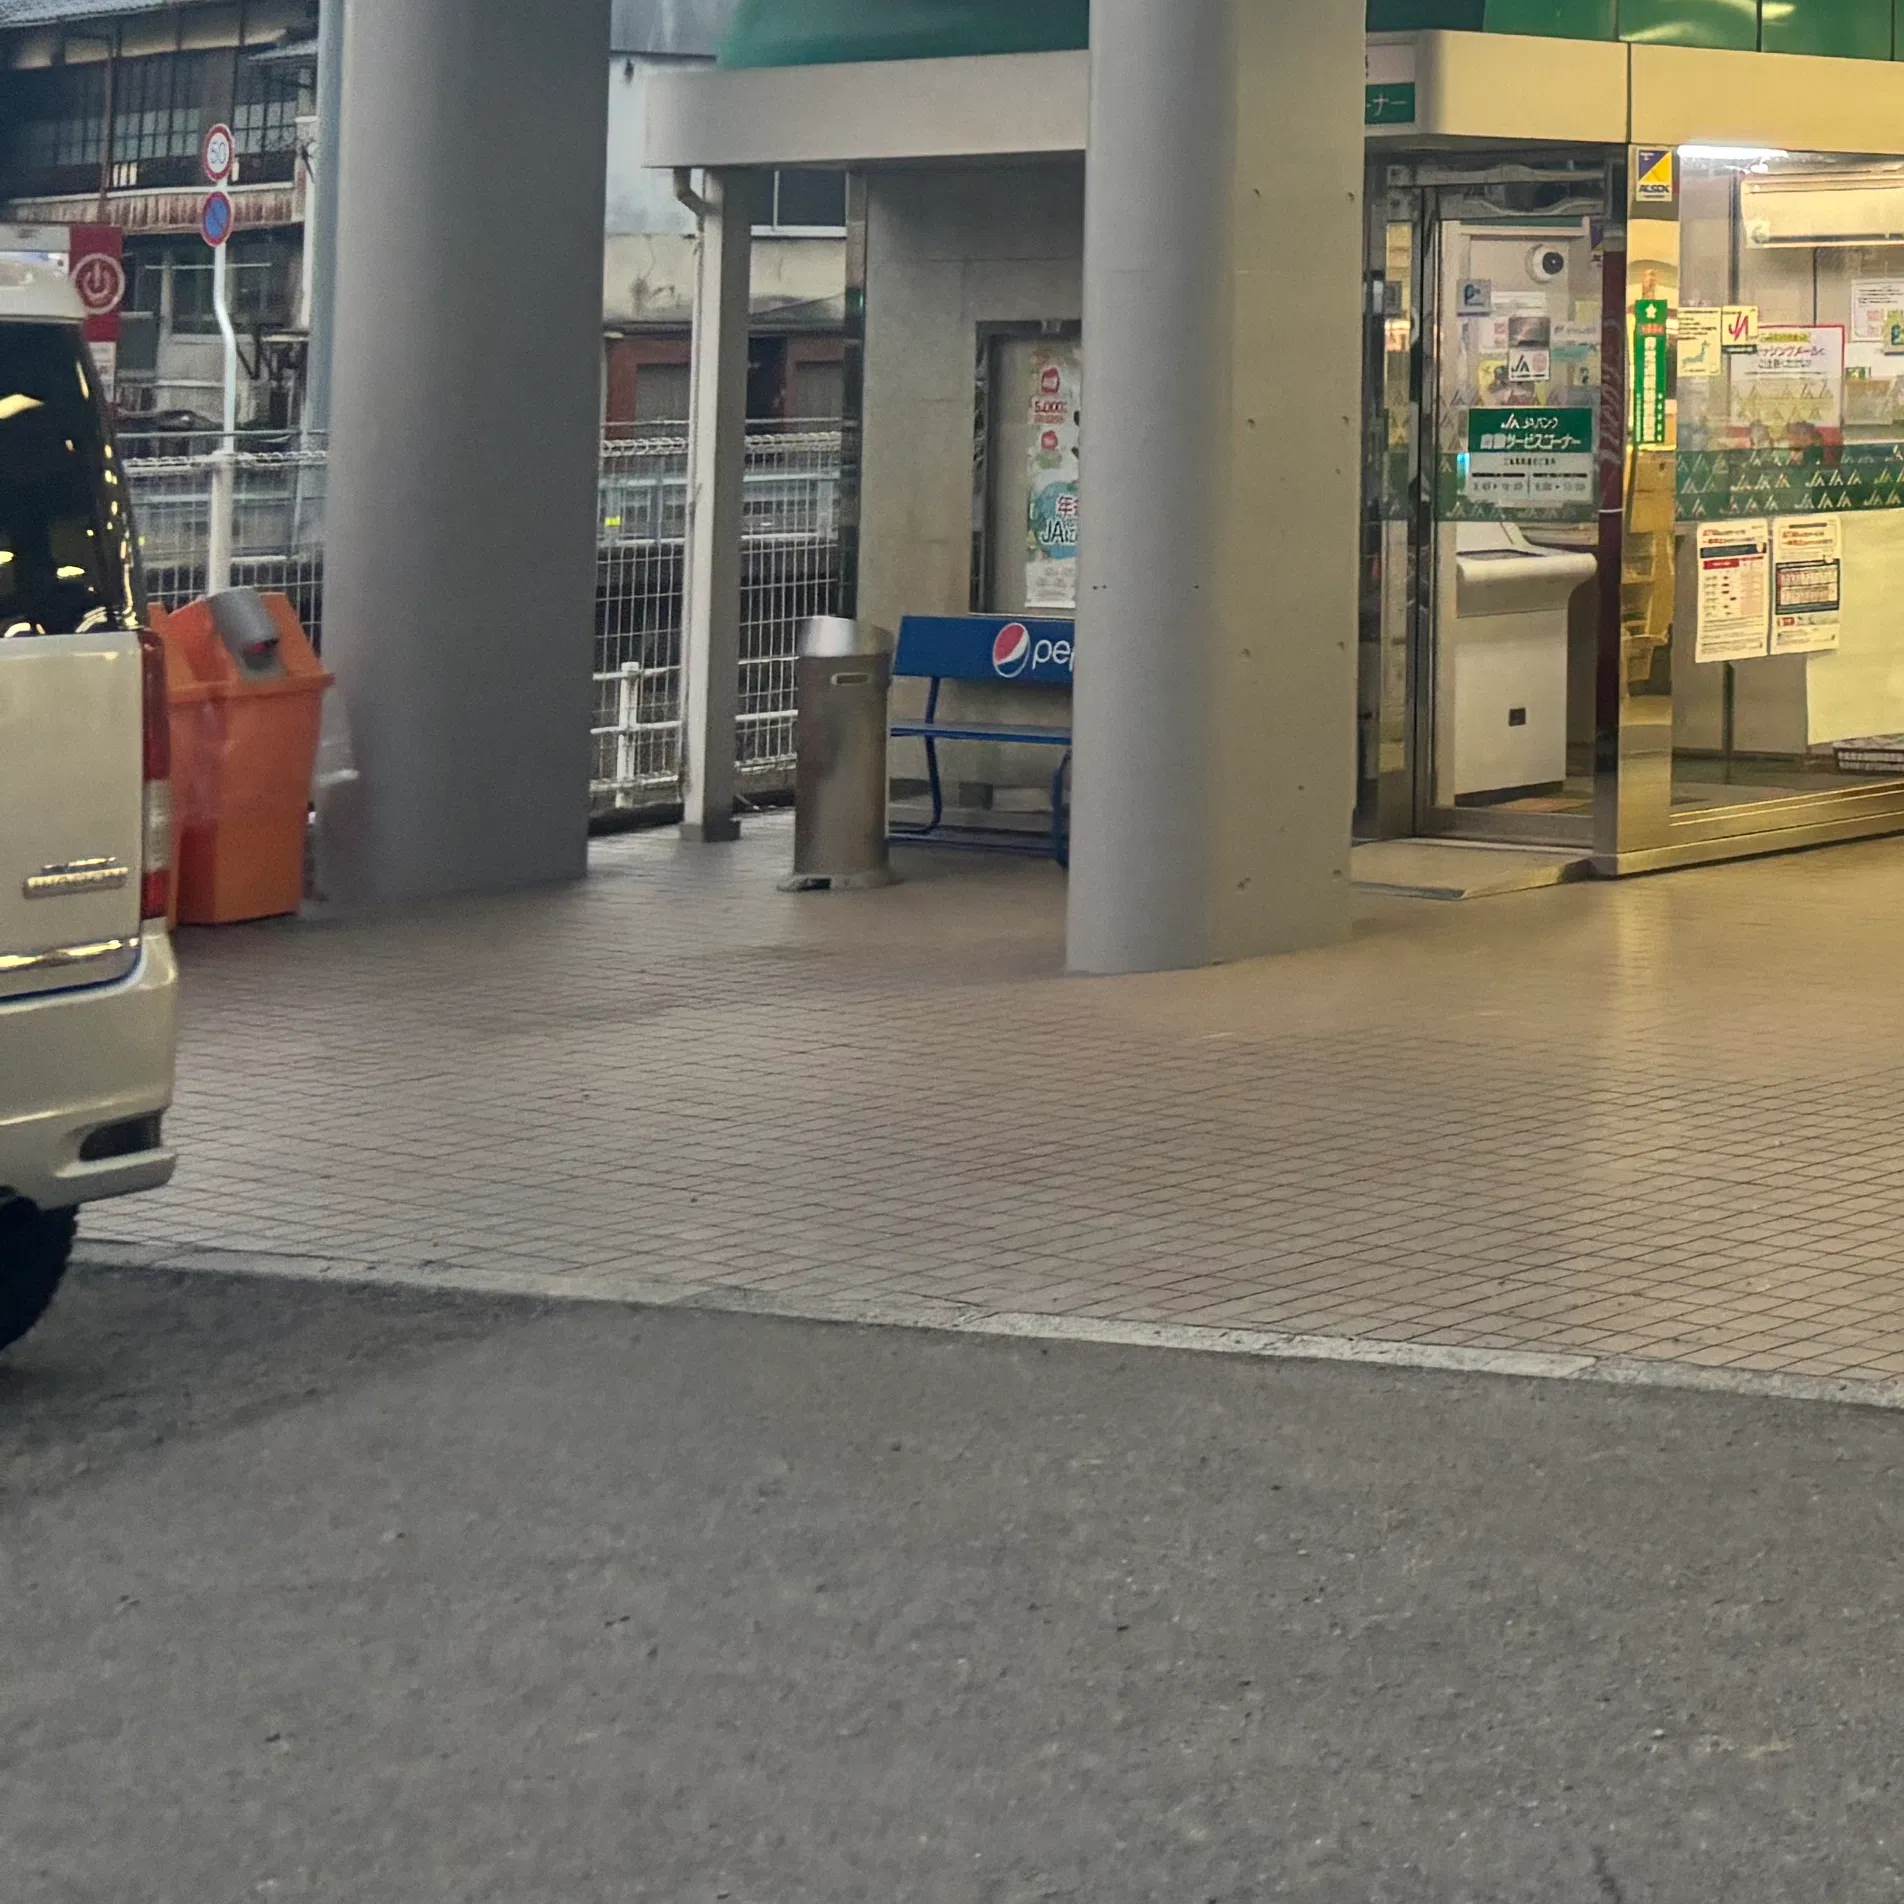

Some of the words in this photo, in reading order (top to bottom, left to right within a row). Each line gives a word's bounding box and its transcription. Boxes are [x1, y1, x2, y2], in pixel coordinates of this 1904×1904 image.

[1367, 92, 1408, 117] ナー
[210, 139, 226, 165] 50
[1031, 638, 1075, 672] pe
